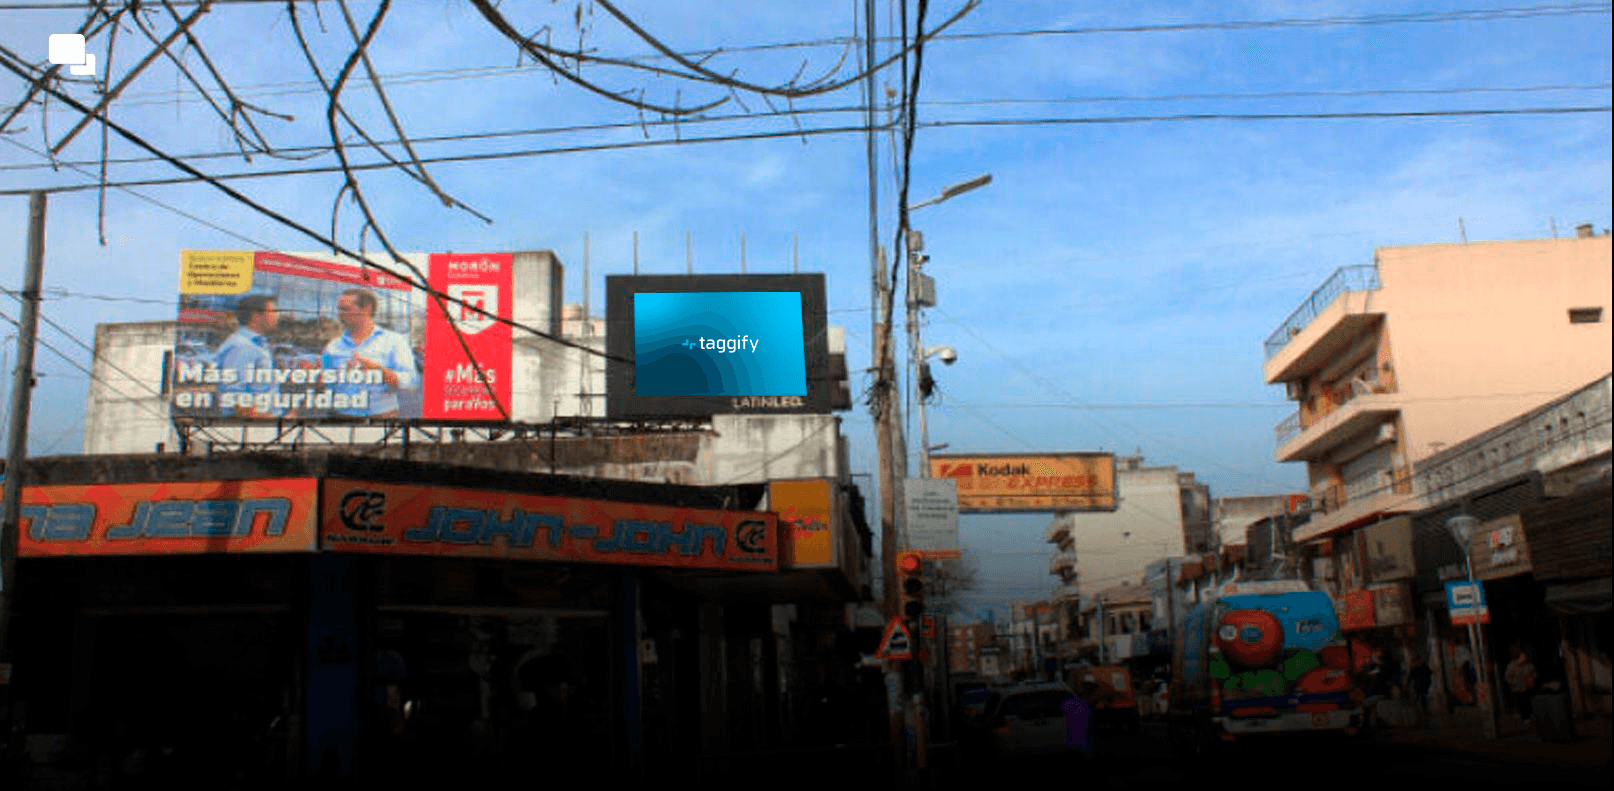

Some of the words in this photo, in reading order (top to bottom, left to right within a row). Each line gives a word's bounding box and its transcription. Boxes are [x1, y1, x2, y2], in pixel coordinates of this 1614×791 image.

[699, 335, 759, 353] taggify
[179, 363, 237, 383] Más
[245, 362, 384, 384] inversión
[176, 393, 214, 408] en
[220, 389, 370, 413] seguridad
[977, 463, 1030, 476] Kodak
